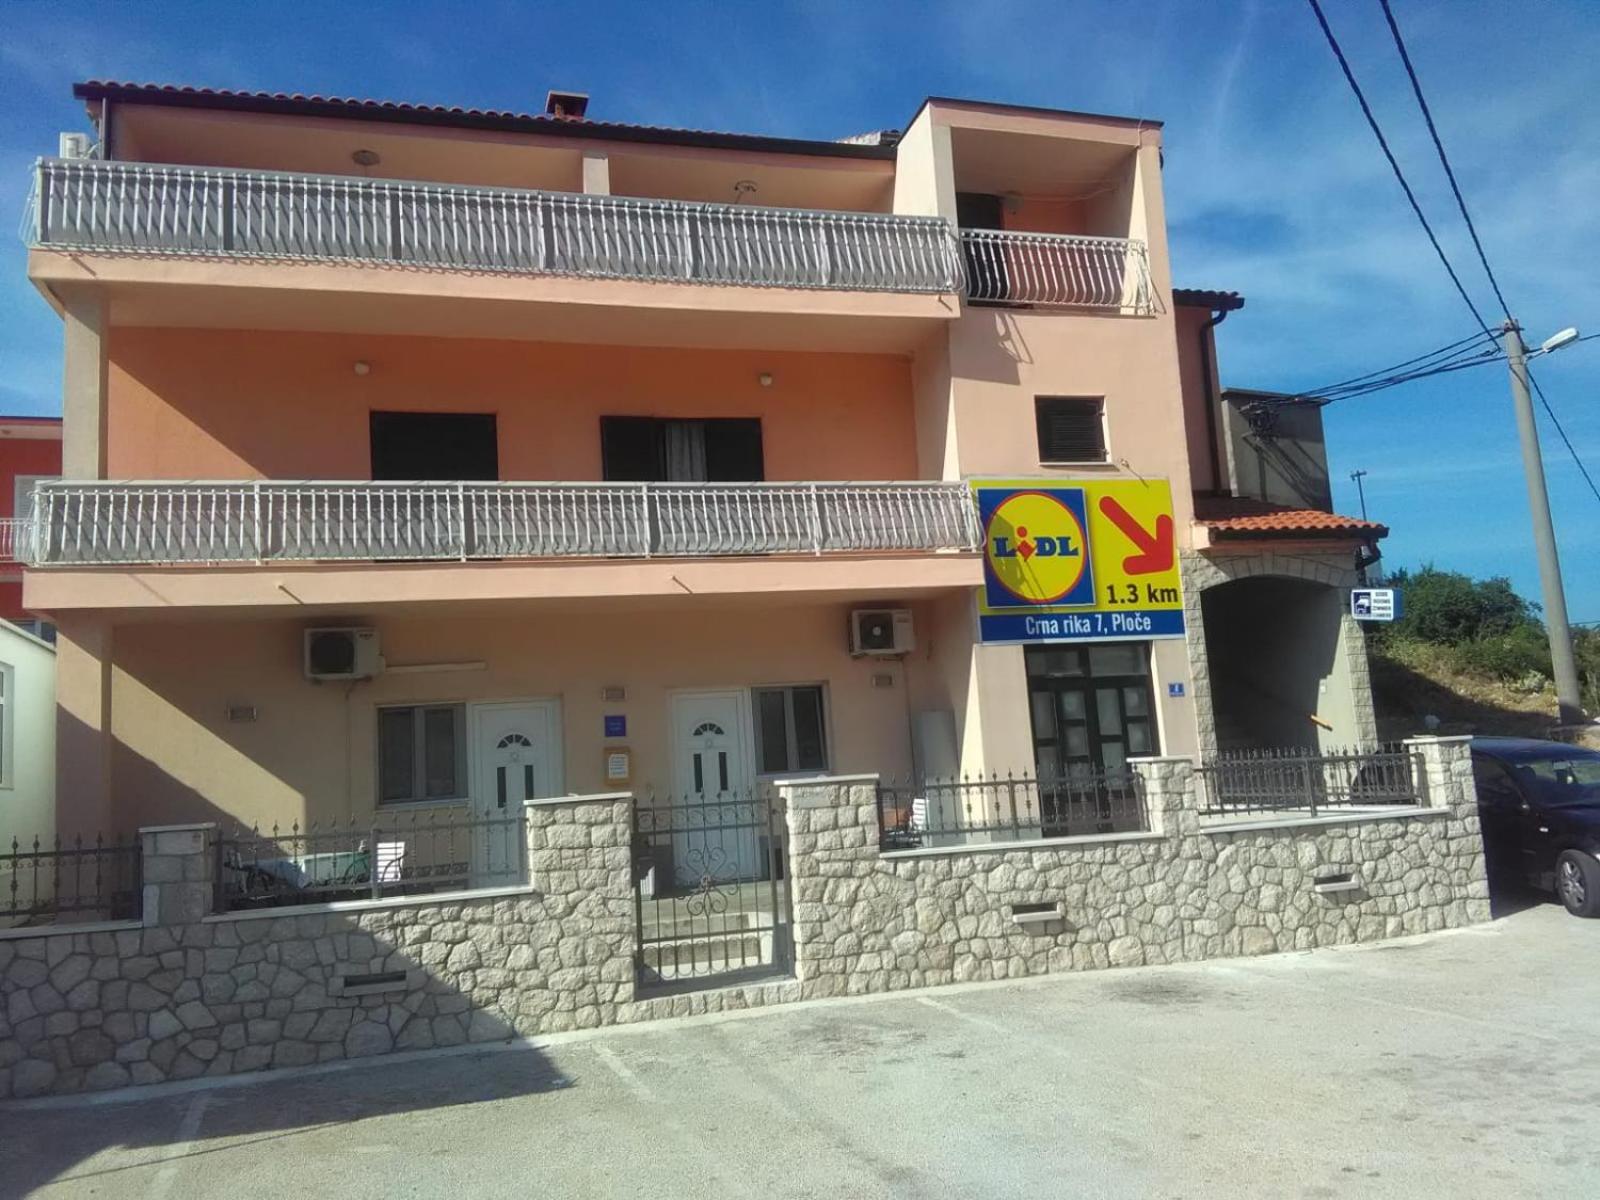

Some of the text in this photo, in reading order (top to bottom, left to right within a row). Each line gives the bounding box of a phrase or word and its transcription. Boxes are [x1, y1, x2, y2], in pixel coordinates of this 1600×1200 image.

[1107, 583, 1178, 604] 1.3 km
[1025, 611, 1151, 635] Crna rika 7, Ploče
